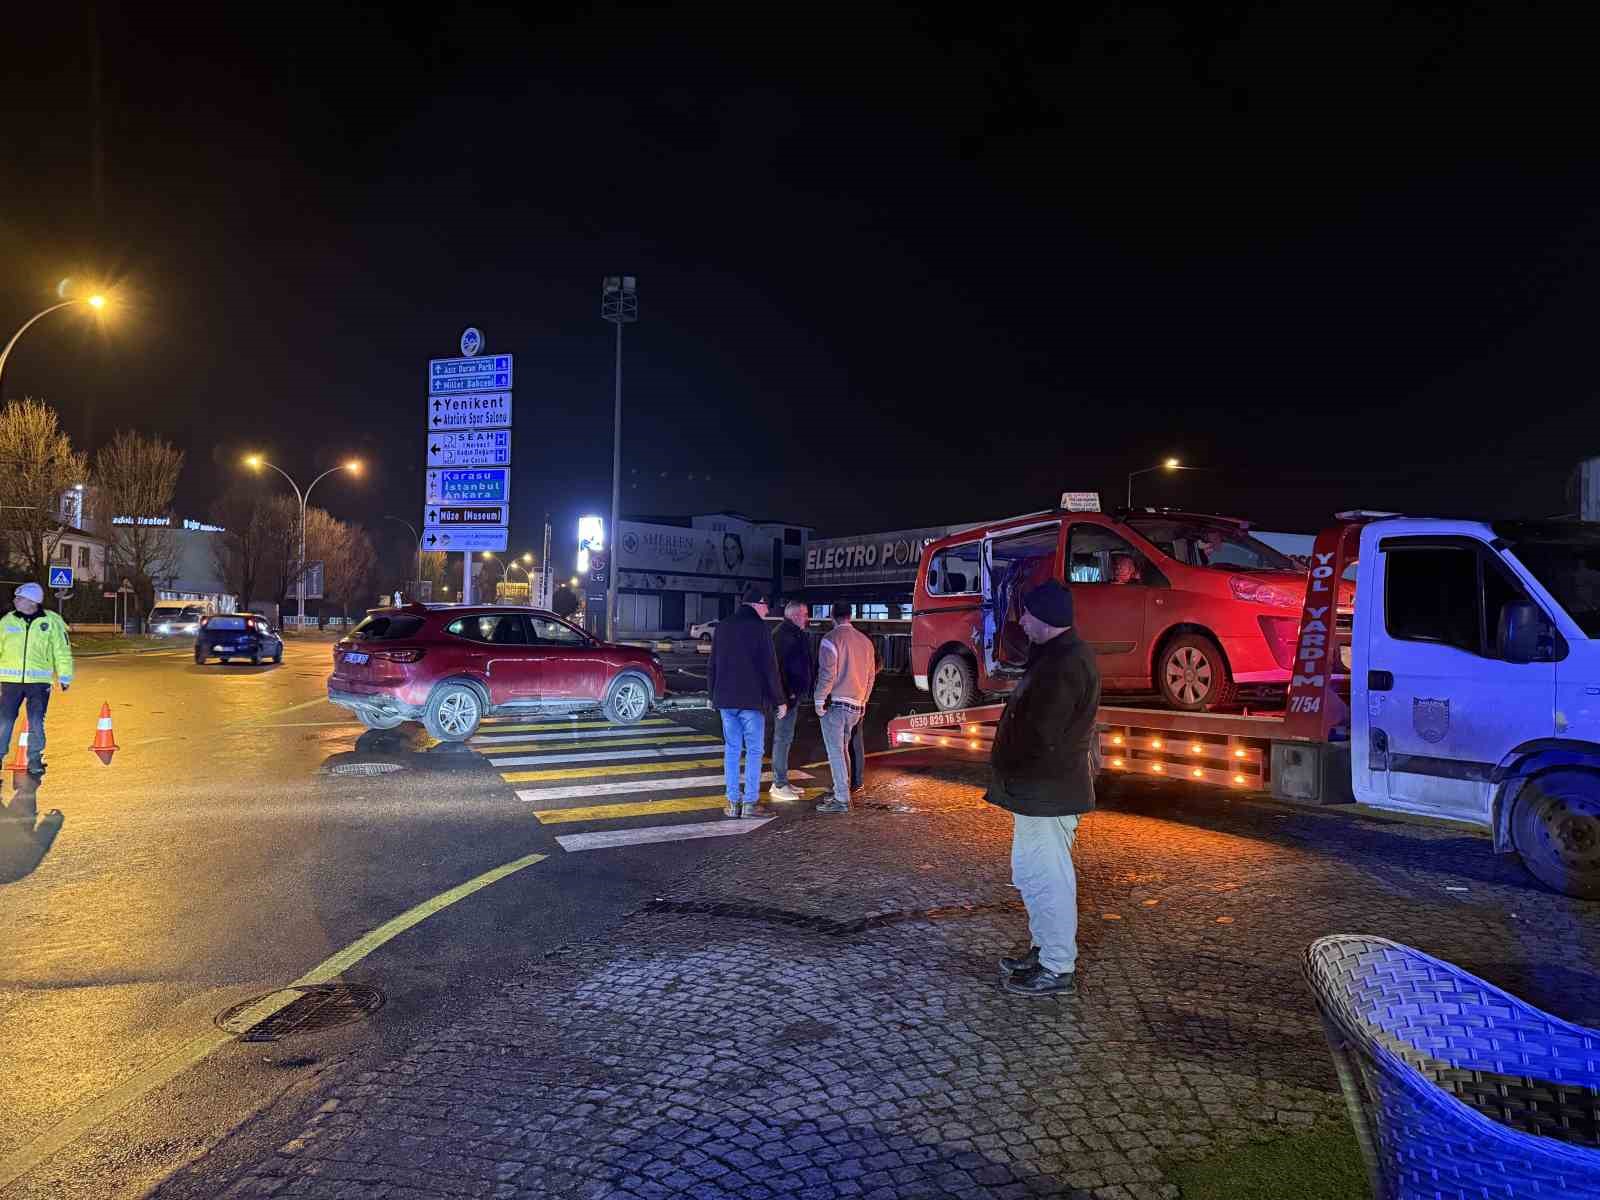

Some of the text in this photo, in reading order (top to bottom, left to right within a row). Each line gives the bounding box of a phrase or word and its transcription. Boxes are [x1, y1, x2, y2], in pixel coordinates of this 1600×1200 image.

[444, 397, 504, 410] Yenikent
[444, 412, 507, 425] Atatürk Spor Salonu
[458, 432, 494, 441] SEAH
[443, 471, 491, 481] Karasu
[444, 480, 500, 491] İstanbul
[444, 491, 491, 499] Ankara
[440, 510, 501, 521] Müze (Museum)
[805, 544, 877, 570] ELECTRO
[1311, 552, 1336, 592] YOL
[1292, 606, 1332, 688] YARDIM
[1290, 695, 1321, 713] 7/54
[955, 711, 967, 723] 54
